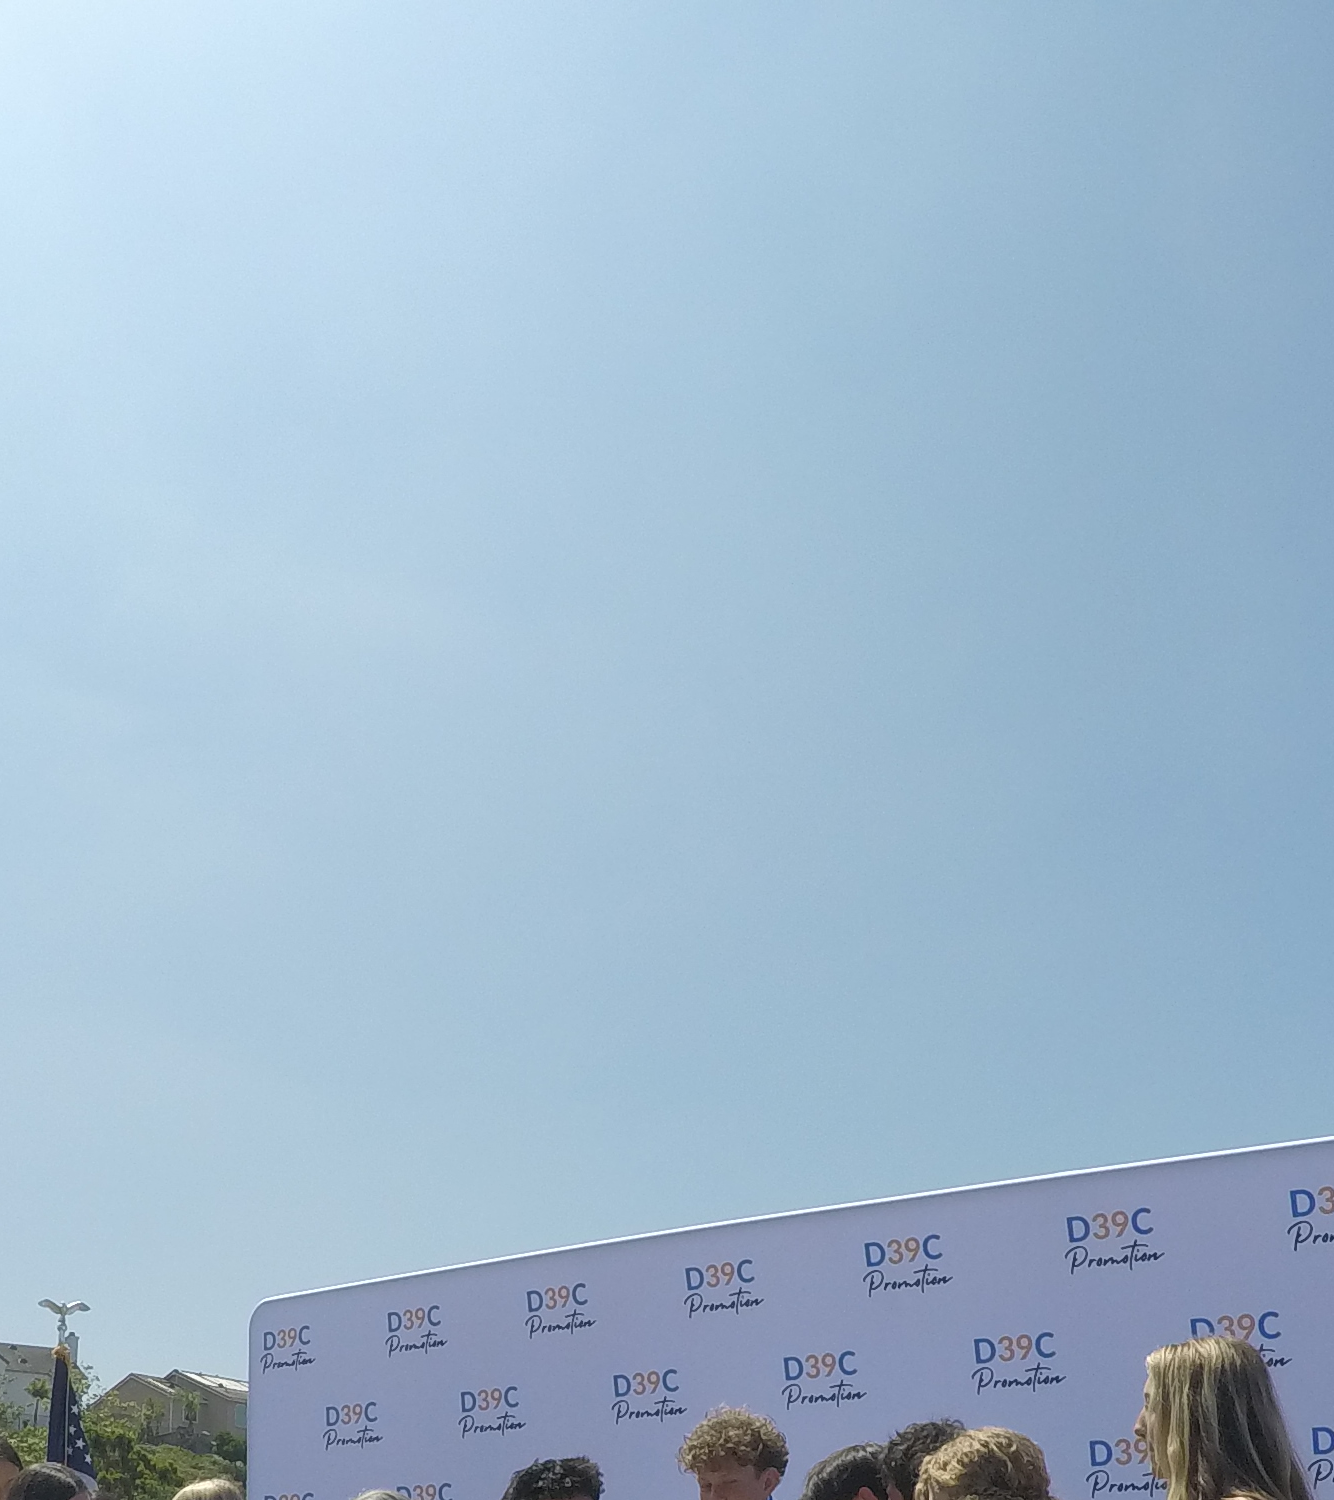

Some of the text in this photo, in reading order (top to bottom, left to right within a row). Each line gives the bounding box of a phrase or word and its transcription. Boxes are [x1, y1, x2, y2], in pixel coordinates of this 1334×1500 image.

[1067, 1208, 1153, 1243] D39C
[864, 1234, 943, 1267] D39C
[1065, 1239, 1165, 1275] Promotion
[685, 1259, 755, 1291] D39C
[863, 1264, 953, 1297] Promotion
[527, 1283, 588, 1312] D39C
[684, 1287, 764, 1318] Promotion
[388, 1305, 441, 1332] D39C
[525, 1309, 596, 1339] Promotion
[264, 1326, 310, 1351] D39C
[385, 1330, 448, 1358] Promotion
[974, 1332, 1056, 1364] D39C
[260, 1349, 316, 1374] Promotion
[783, 1351, 857, 1381] D39C
[613, 1369, 679, 1398] D39C
[971, 1362, 1066, 1395] Promotion
[461, 1386, 519, 1412] D39C
[782, 1379, 867, 1410] Promotion
[326, 1402, 378, 1426] D39C
[458, 1411, 526, 1439] Promotion
[612, 1396, 687, 1425] Promotion
[323, 1425, 383, 1451] Promotion
[1085, 1469, 1168, 1499] Promotio
